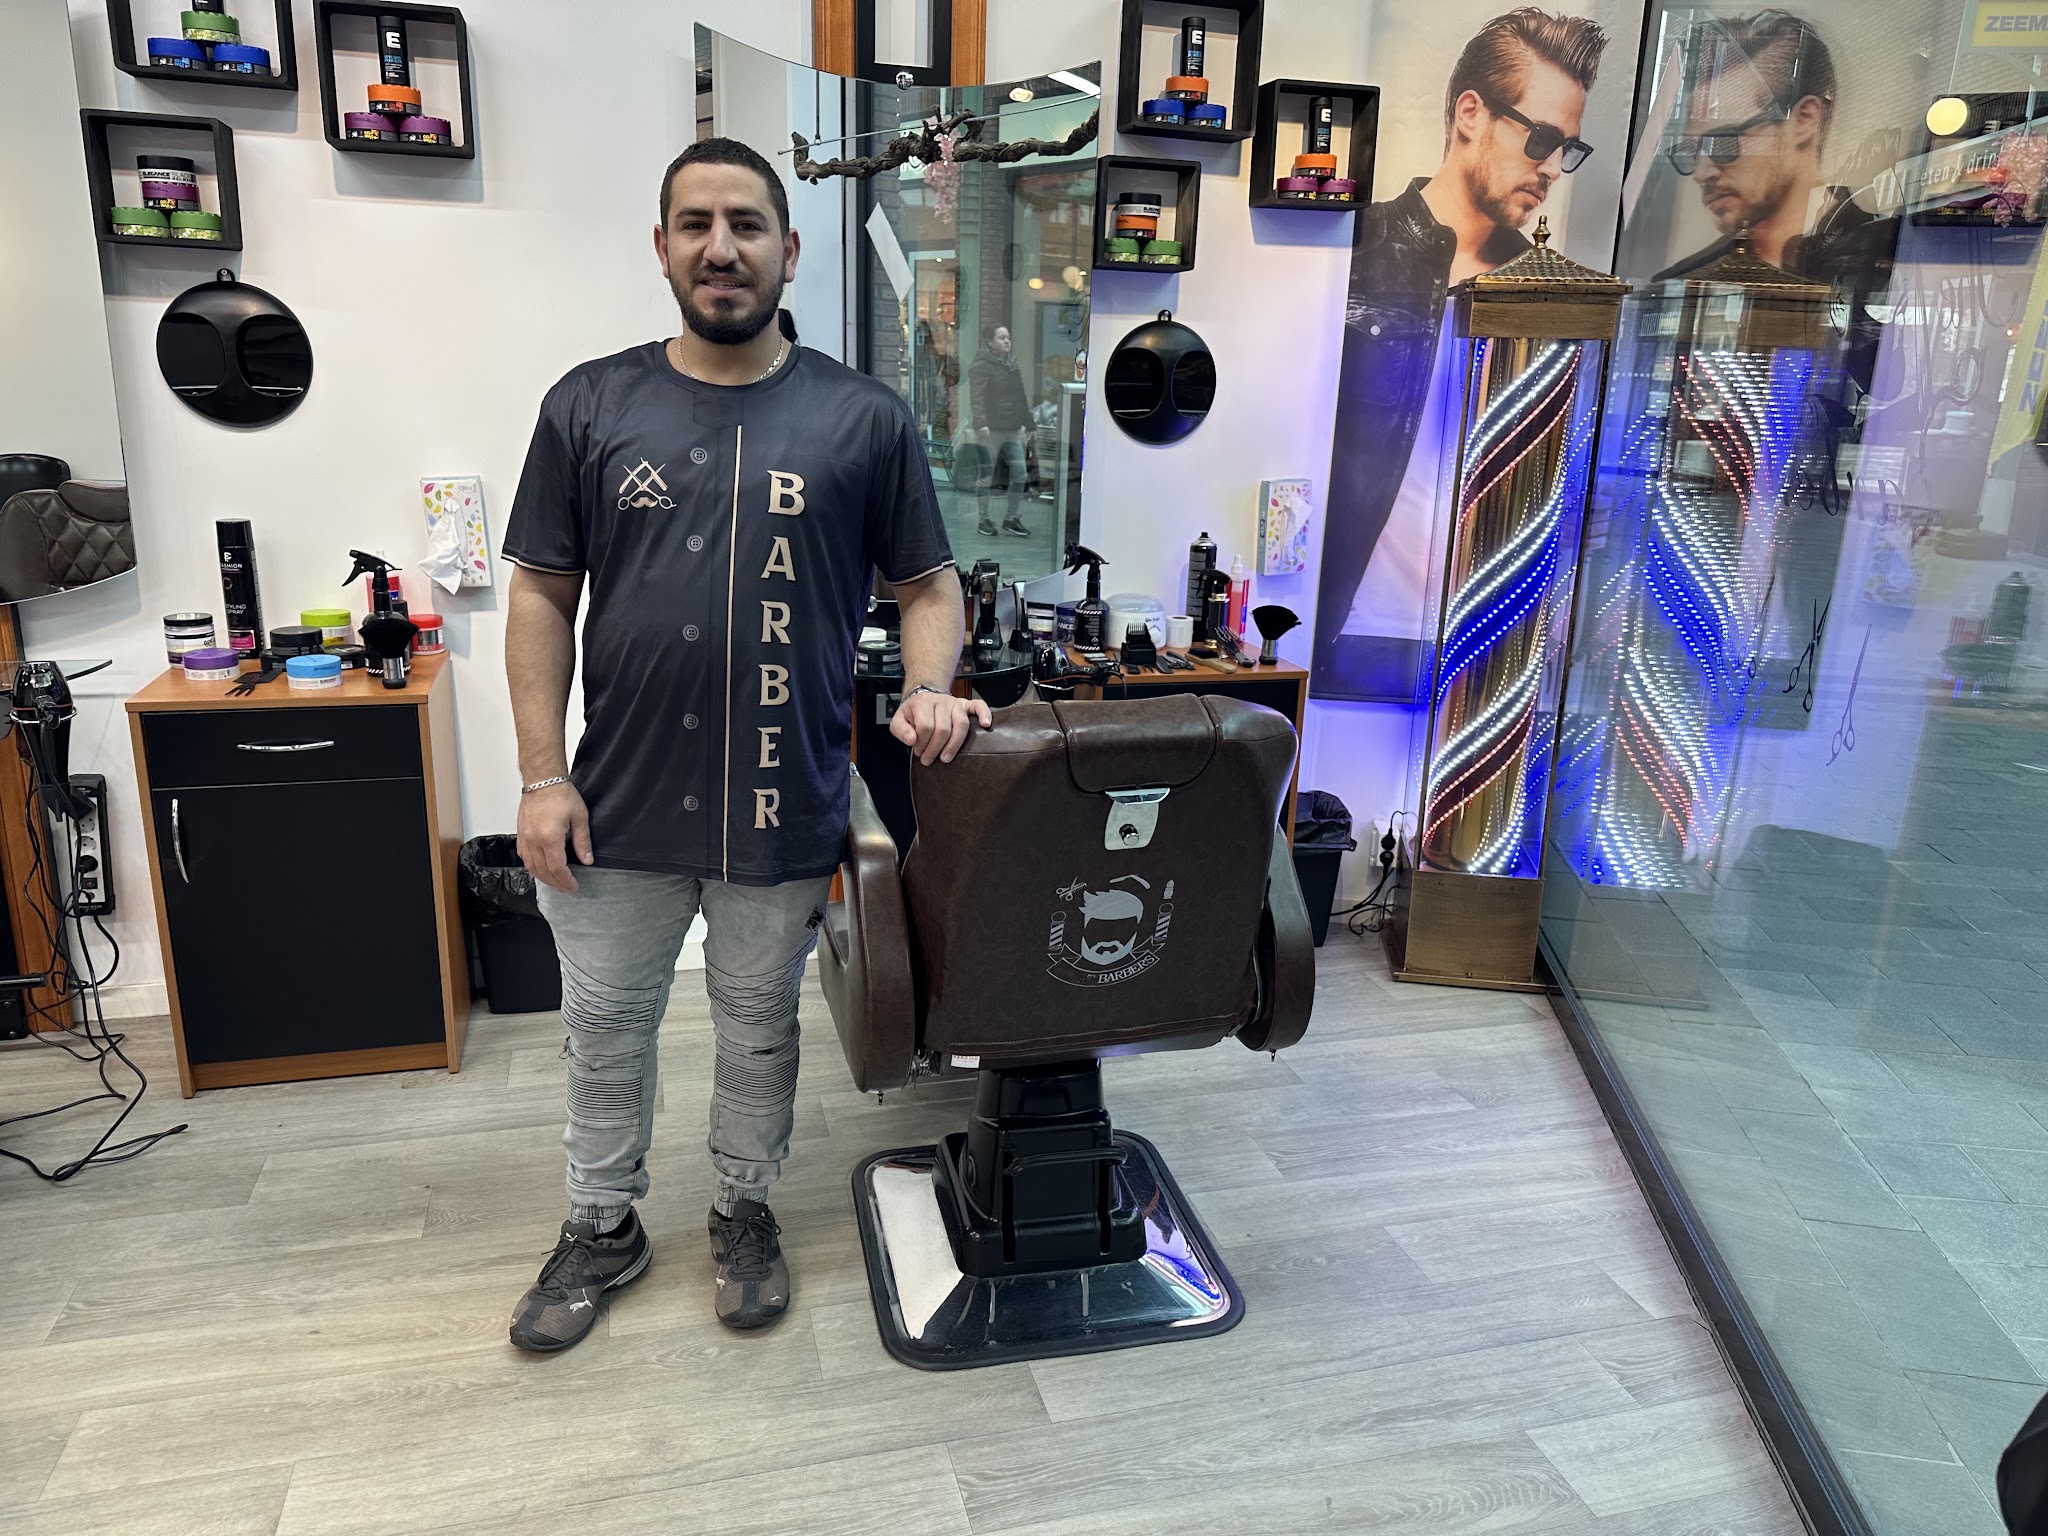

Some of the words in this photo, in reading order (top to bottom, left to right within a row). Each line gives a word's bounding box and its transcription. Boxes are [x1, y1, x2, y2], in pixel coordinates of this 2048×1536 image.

[1984, 15, 2048, 32] ZEEM
[1920, 166, 1950, 187] eten
[1966, 144, 2005, 175] drin
[753, 470, 806, 830] BARBER
[1097, 954, 1155, 984] BARBERS
